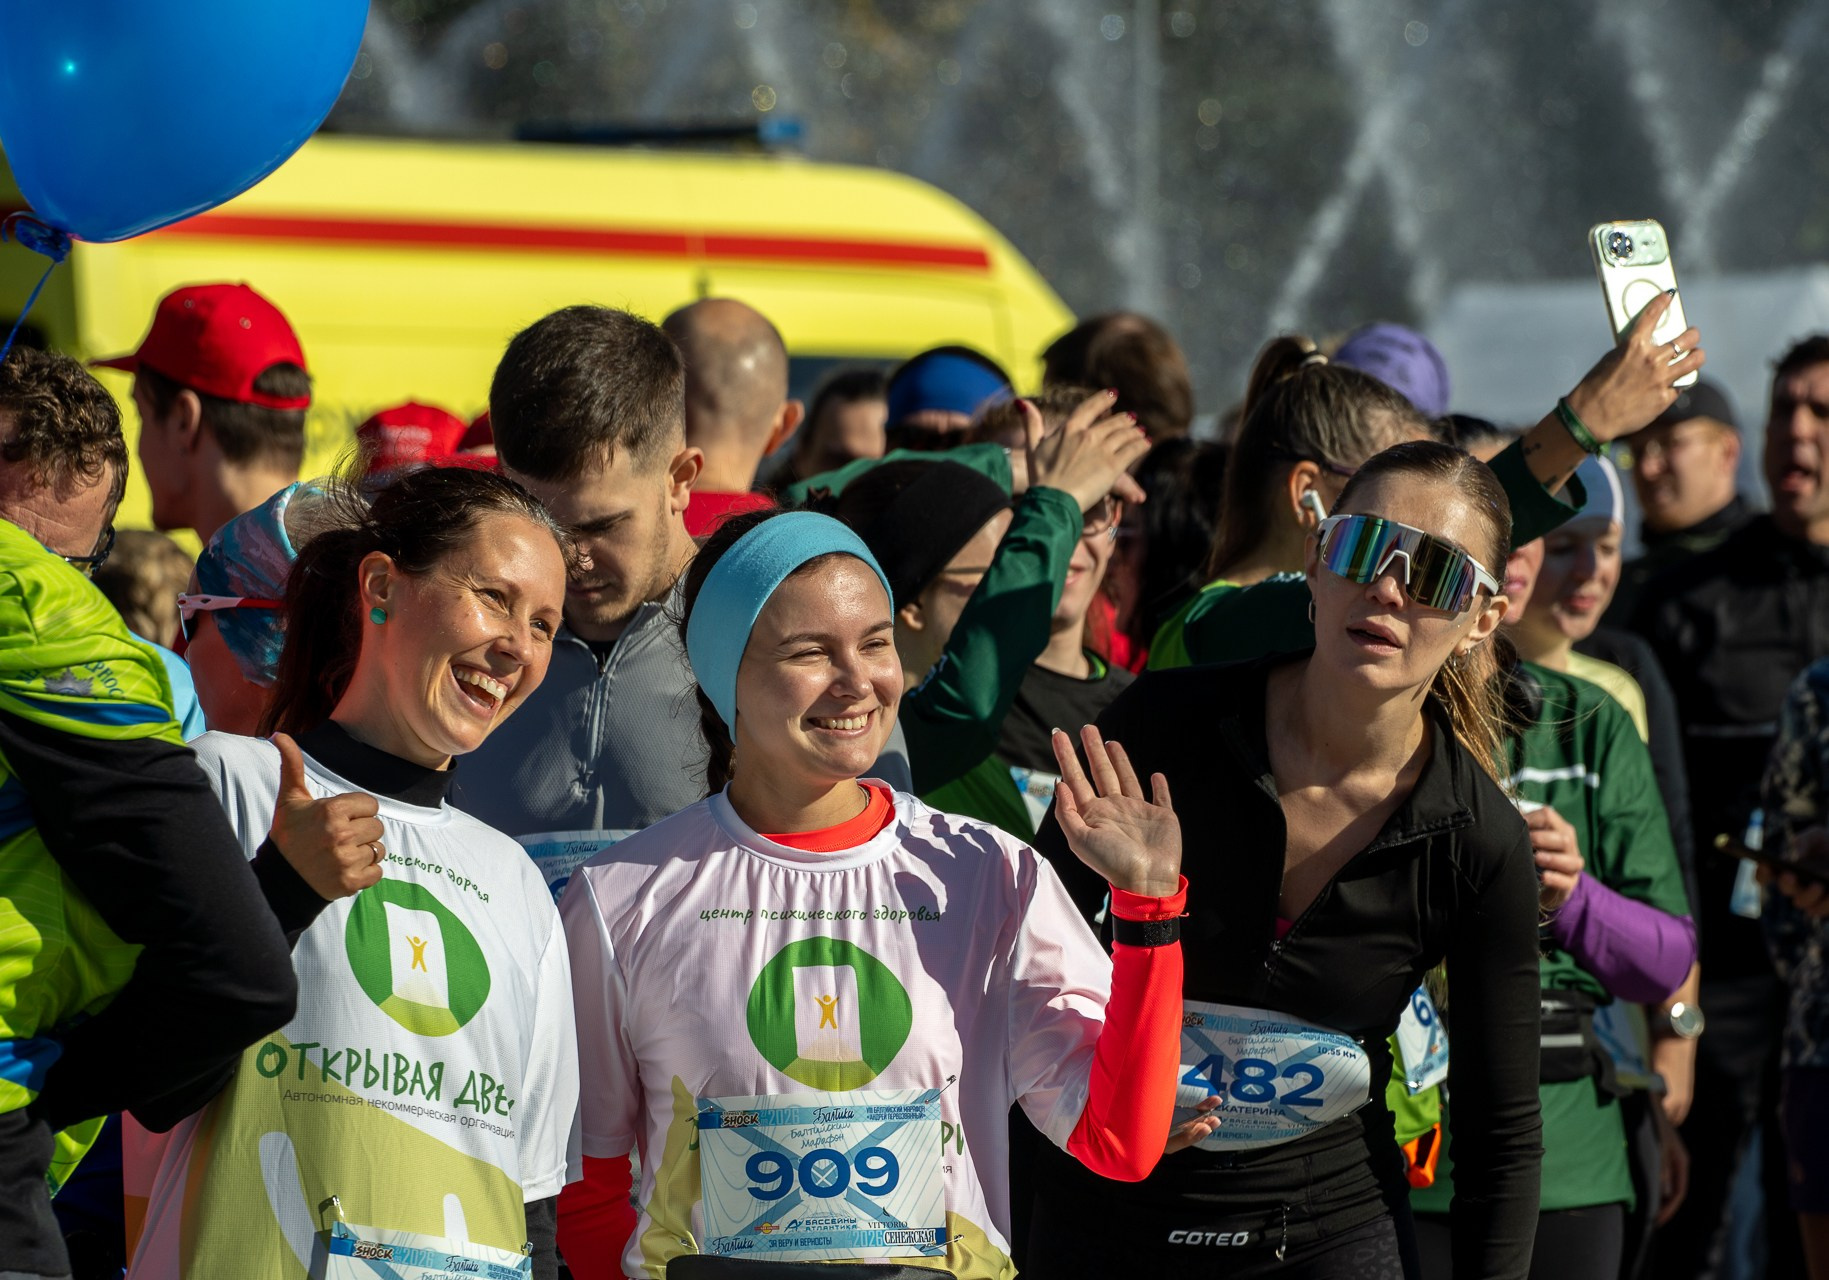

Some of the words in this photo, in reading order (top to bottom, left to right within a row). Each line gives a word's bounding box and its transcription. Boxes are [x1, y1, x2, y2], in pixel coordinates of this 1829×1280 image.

[700, 907, 753, 925] центр
[761, 908, 868, 922] психического
[873, 905, 941, 924] здоровья
[256, 1042, 445, 1102] ОТКРЫВАЯ
[1181, 1054, 1324, 1107] 482
[283, 1089, 364, 1107] Автономная
[367, 1098, 456, 1124] некоммерческая
[813, 1106, 854, 1124] Балтика
[724, 1113, 759, 1126] SHOCK
[768, 1109, 800, 1126] 2026
[745, 1147, 899, 1201] 909
[852, 1231, 883, 1247] 2026
[884, 1229, 935, 1244] СЕНЕЖСКАЯ
[356, 1245, 393, 1260] SHOCK
[402, 1248, 434, 1267] 2026
